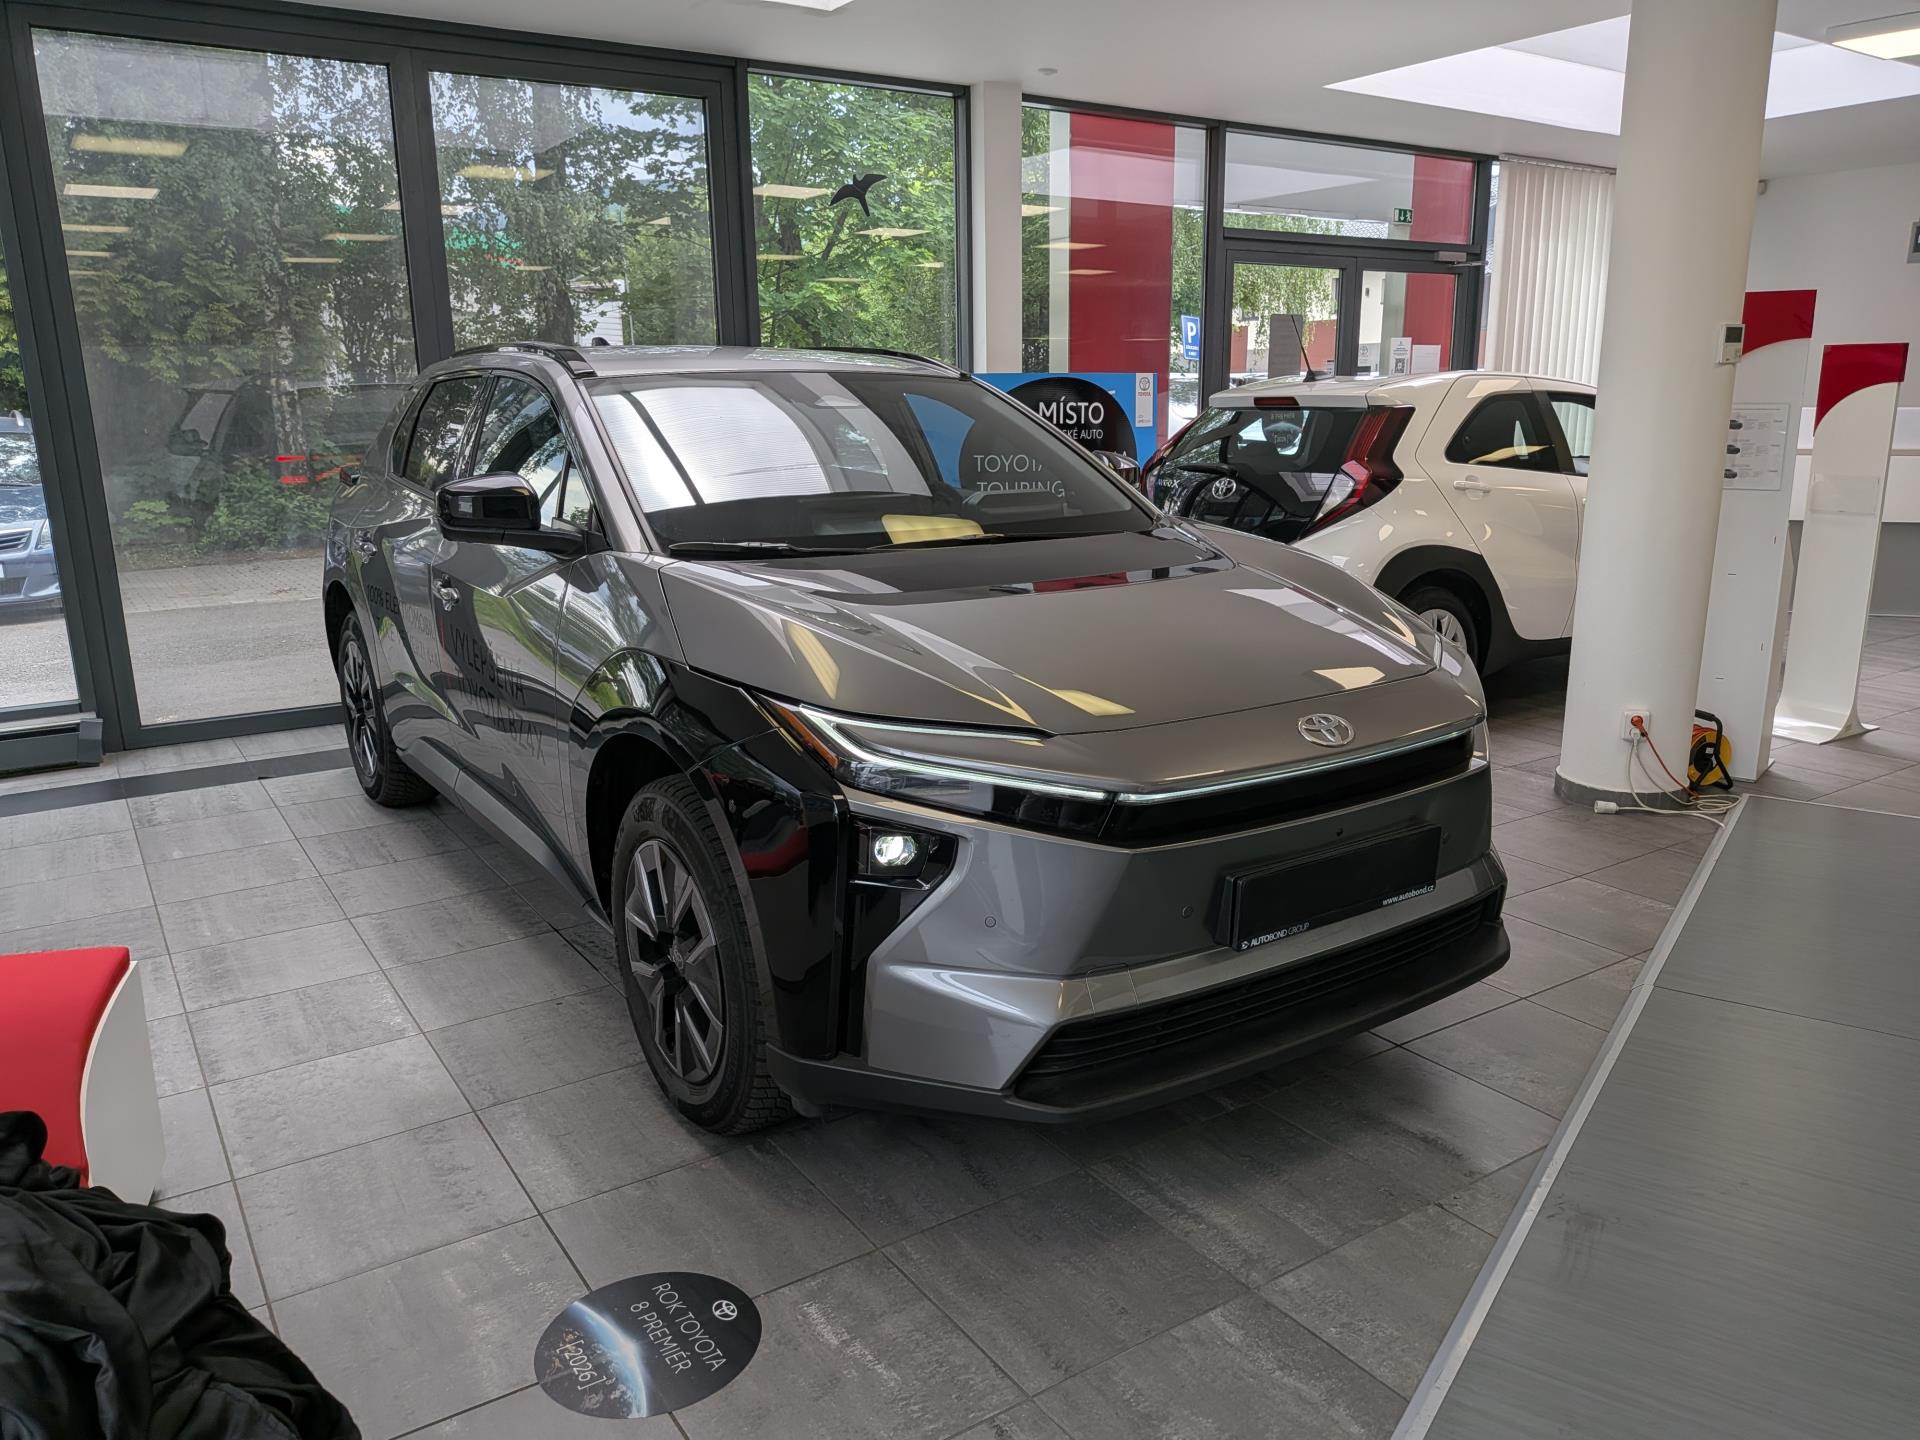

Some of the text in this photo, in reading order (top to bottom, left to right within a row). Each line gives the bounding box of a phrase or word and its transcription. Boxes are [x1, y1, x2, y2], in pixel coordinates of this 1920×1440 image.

[1187, 321, 1197, 344] P
[1039, 395, 1104, 424] MÍSTO
[1080, 429, 1104, 439] AUTO
[1382, 884, 1434, 906] www.autobond.cz
[1250, 921, 1310, 947] AUTOBOND GROUP
[630, 1301, 692, 1375] 8 PREMIÉR
[652, 1282, 728, 1372] ROK TOYOTA
